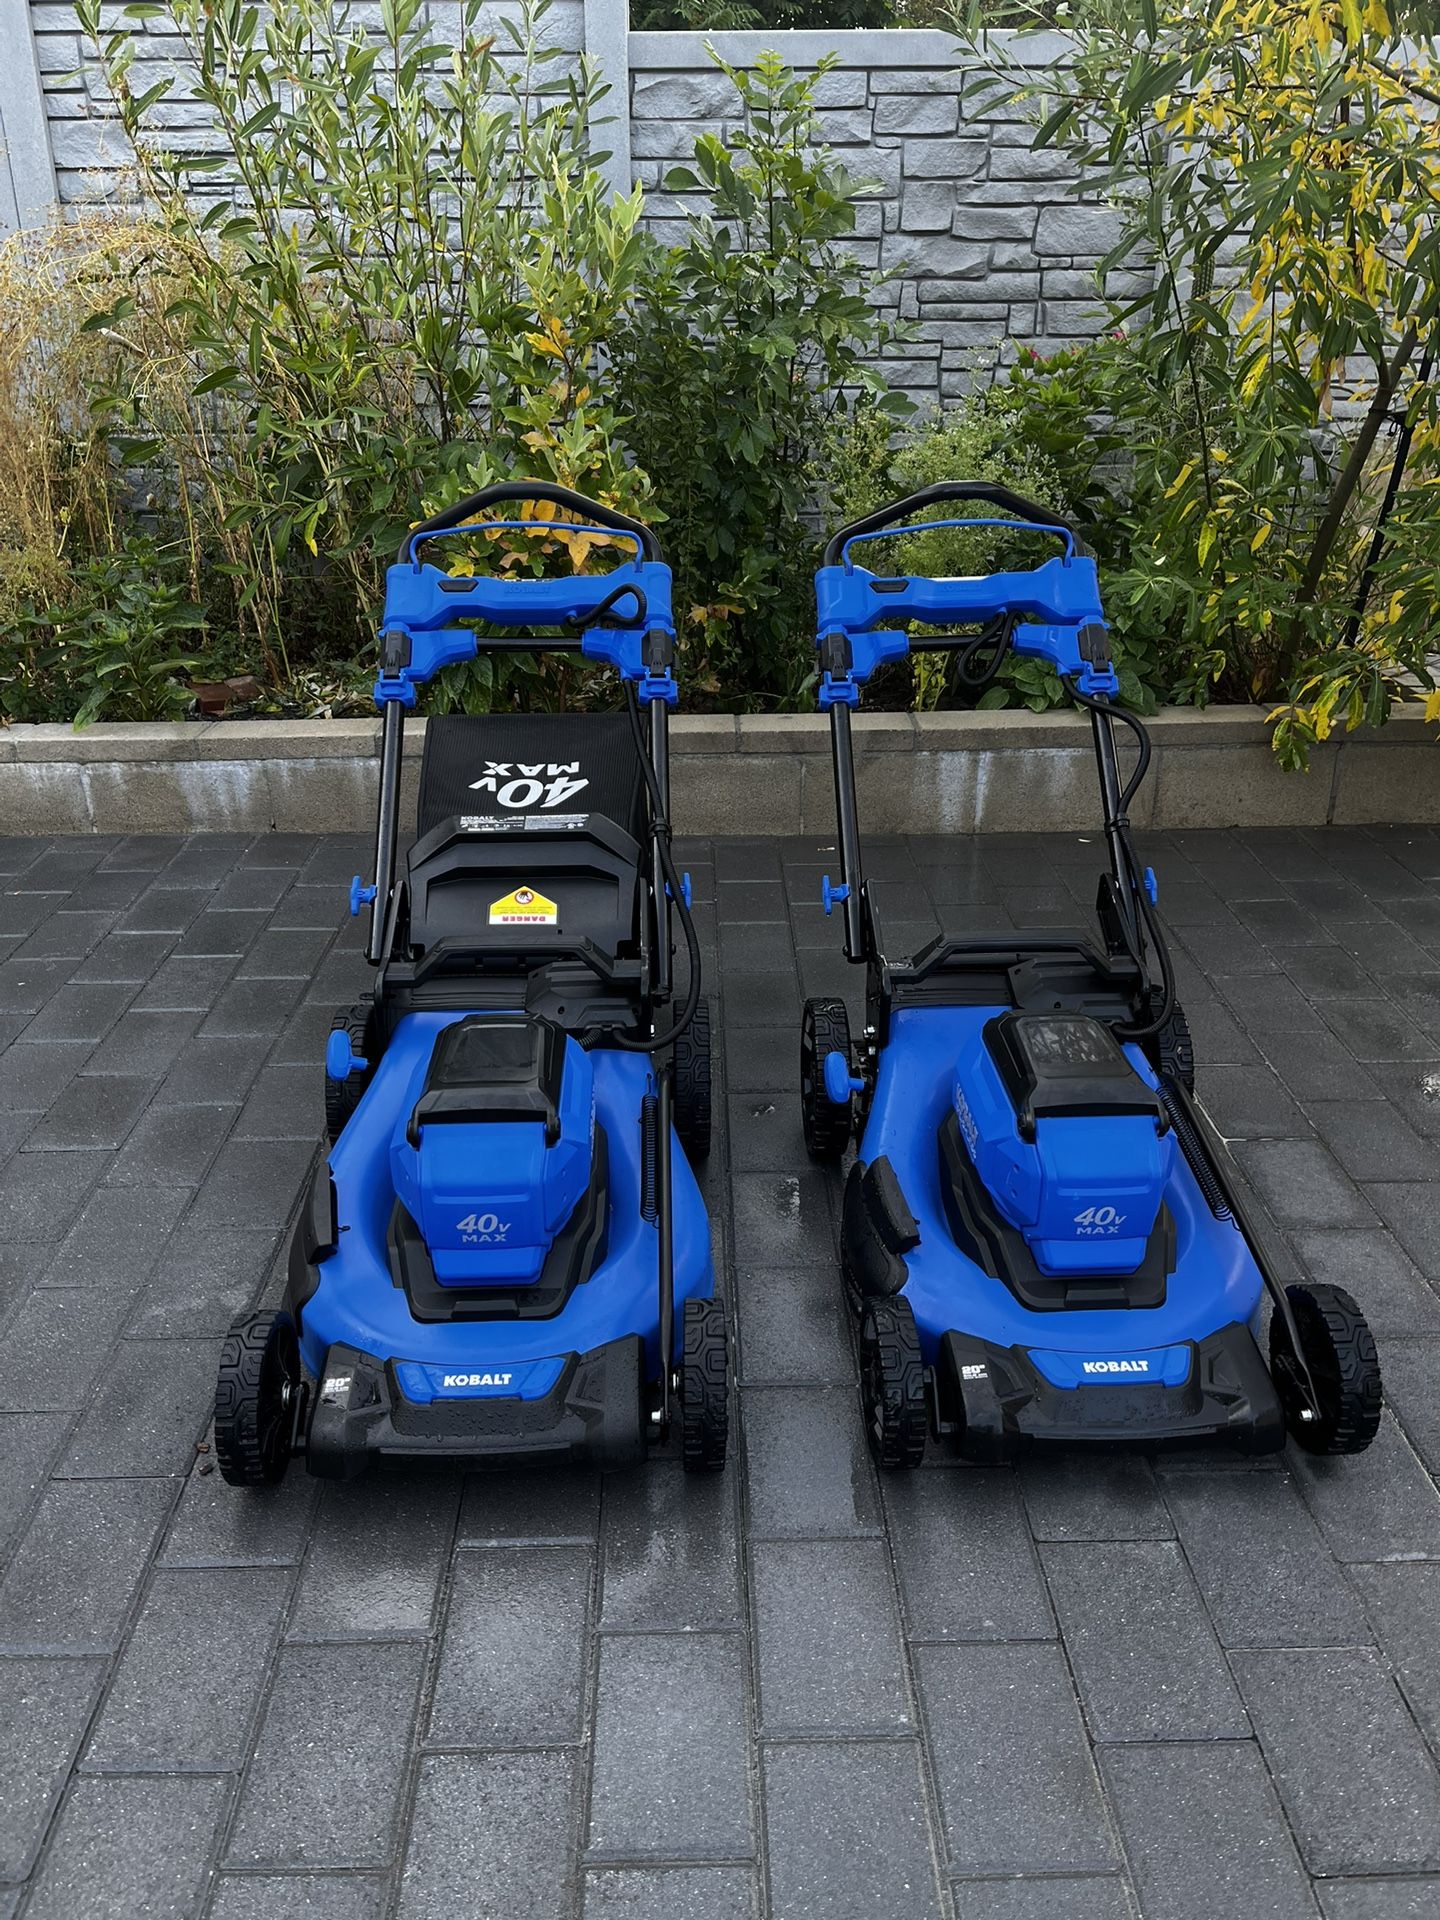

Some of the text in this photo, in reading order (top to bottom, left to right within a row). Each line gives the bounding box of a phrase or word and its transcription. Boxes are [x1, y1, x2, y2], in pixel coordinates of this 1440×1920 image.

[482, 761, 580, 776] MAX
[1076, 1226, 1120, 1235] MAX
[462, 1234, 507, 1243] MAX
[1083, 1360, 1149, 1373] KOBALT
[443, 1373, 512, 1387] KOBALT
